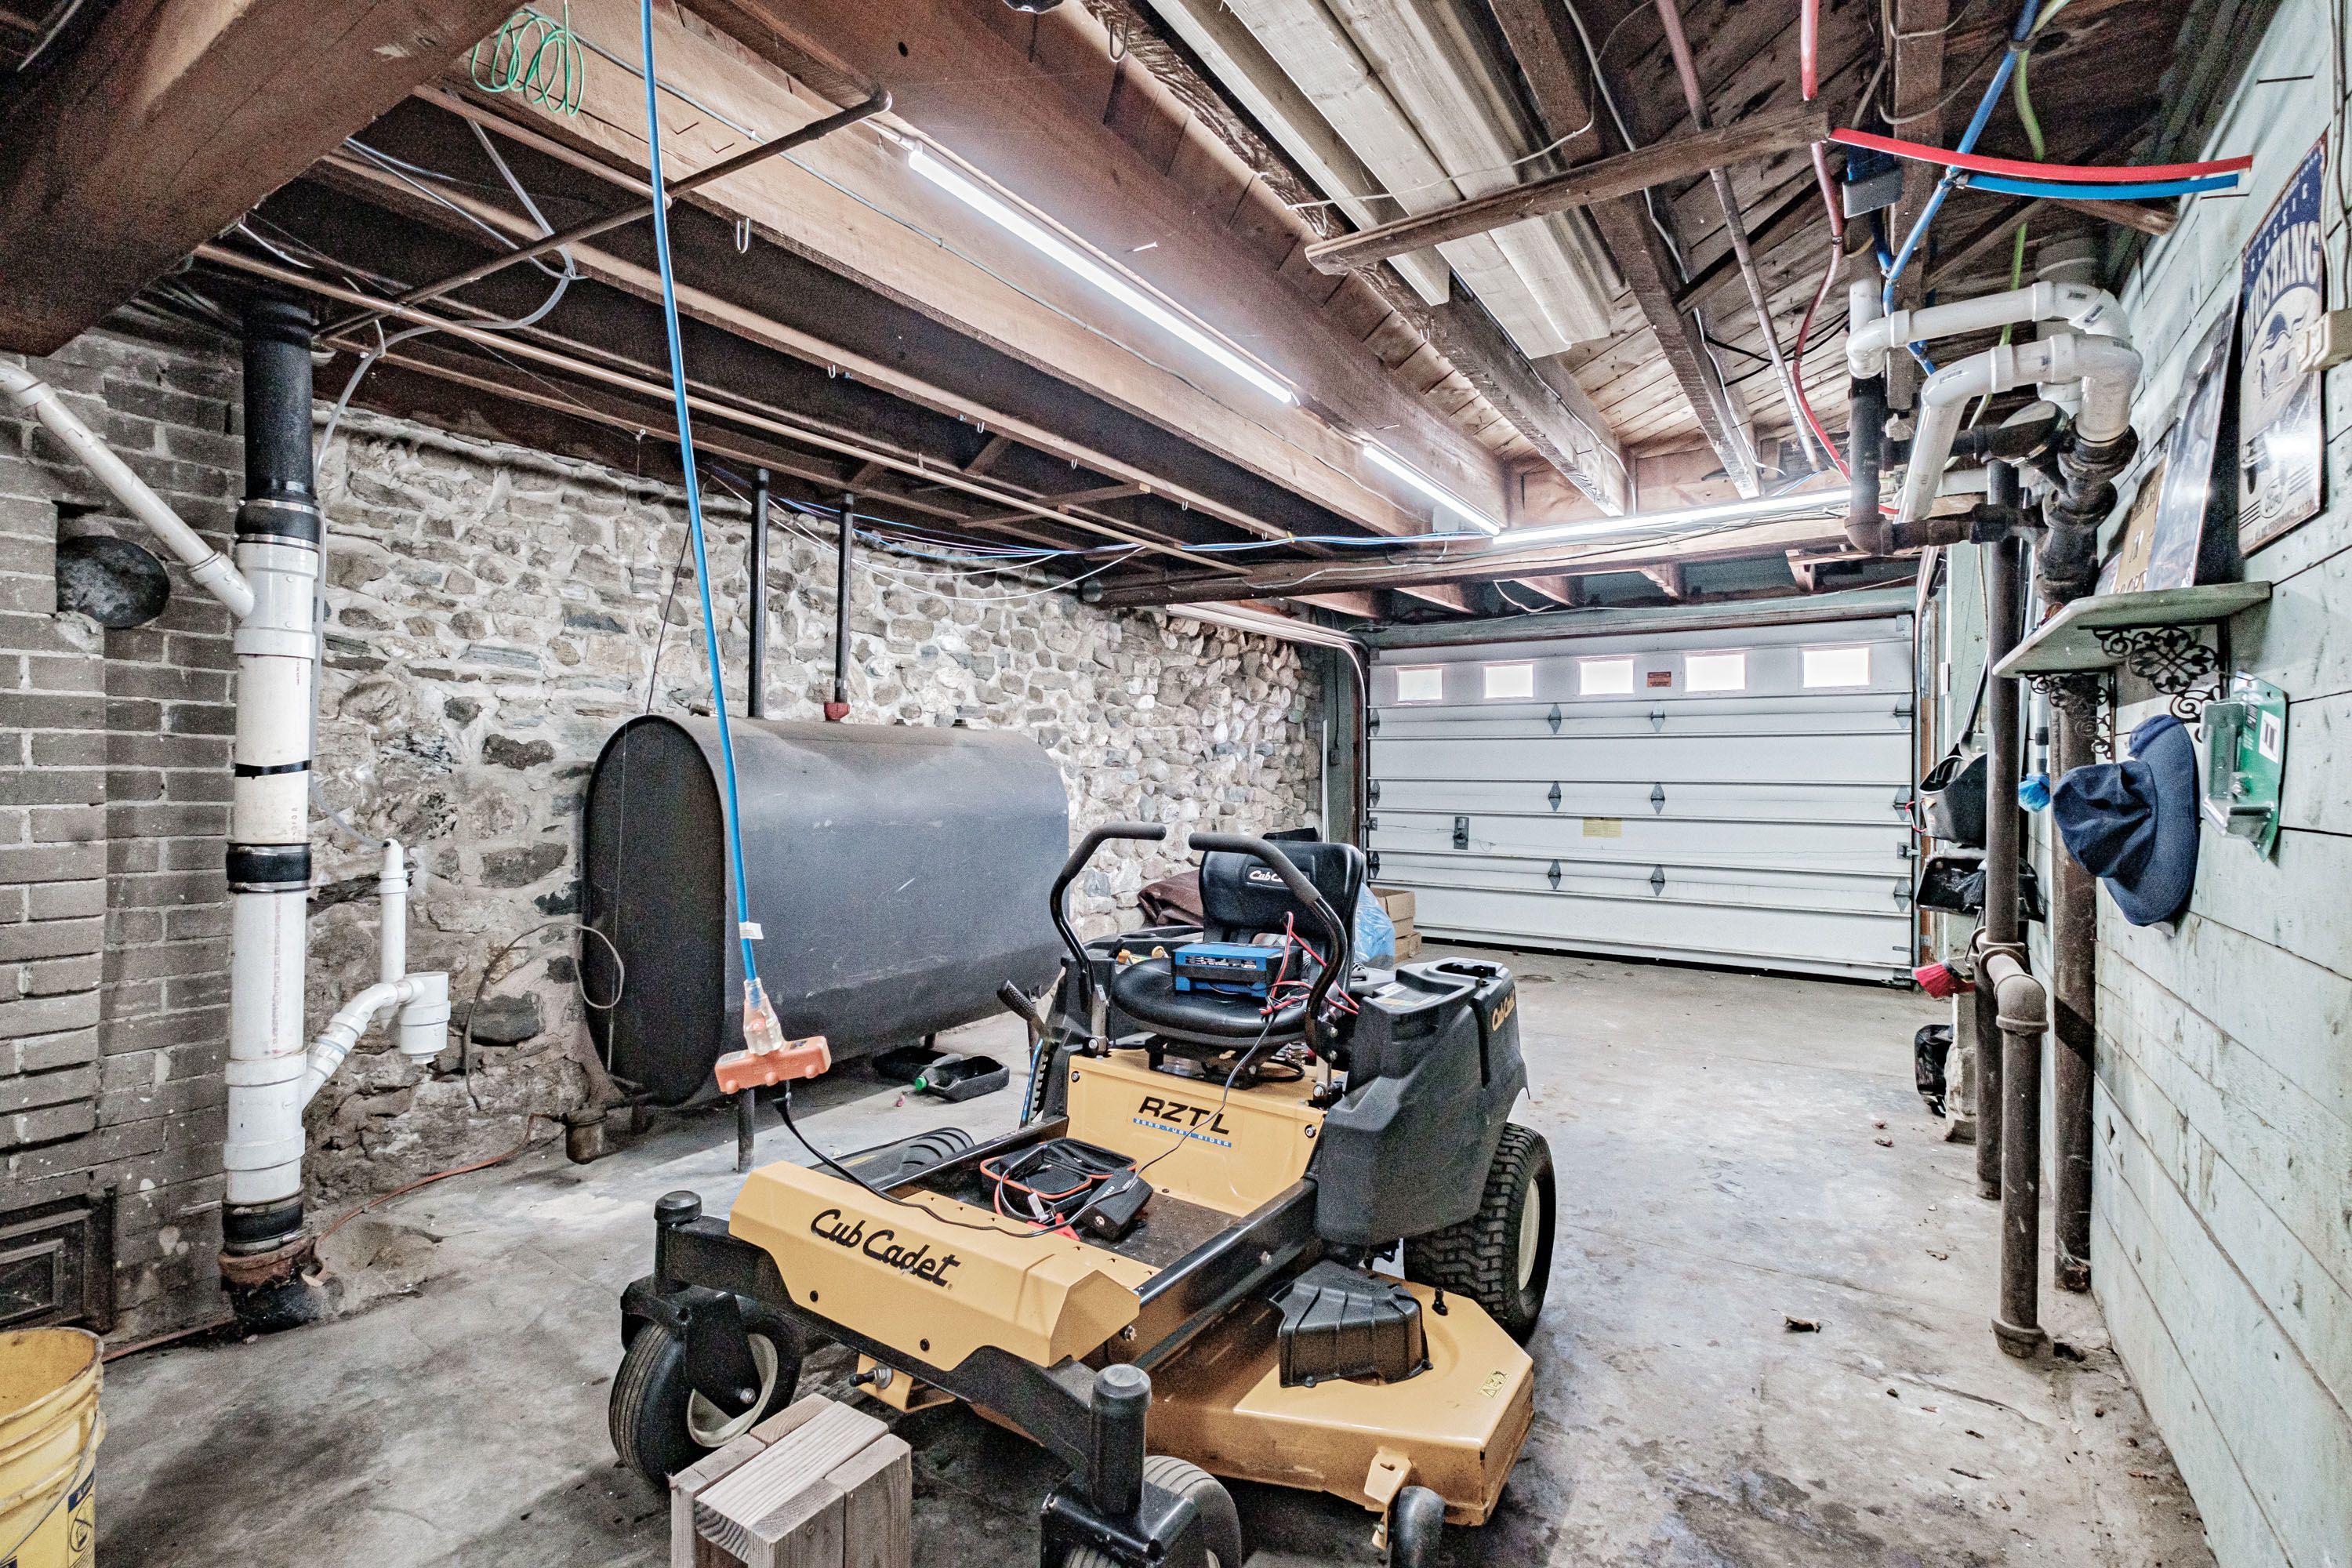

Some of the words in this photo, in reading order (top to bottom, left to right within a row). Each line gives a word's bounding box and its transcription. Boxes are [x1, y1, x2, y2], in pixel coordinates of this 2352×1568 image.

[2241, 220, 2320, 373] MUSTANG
[1197, 1134, 1229, 1147] RIDER
[810, 1208, 866, 1248] Cub
[862, 1229, 961, 1287] Cadet
